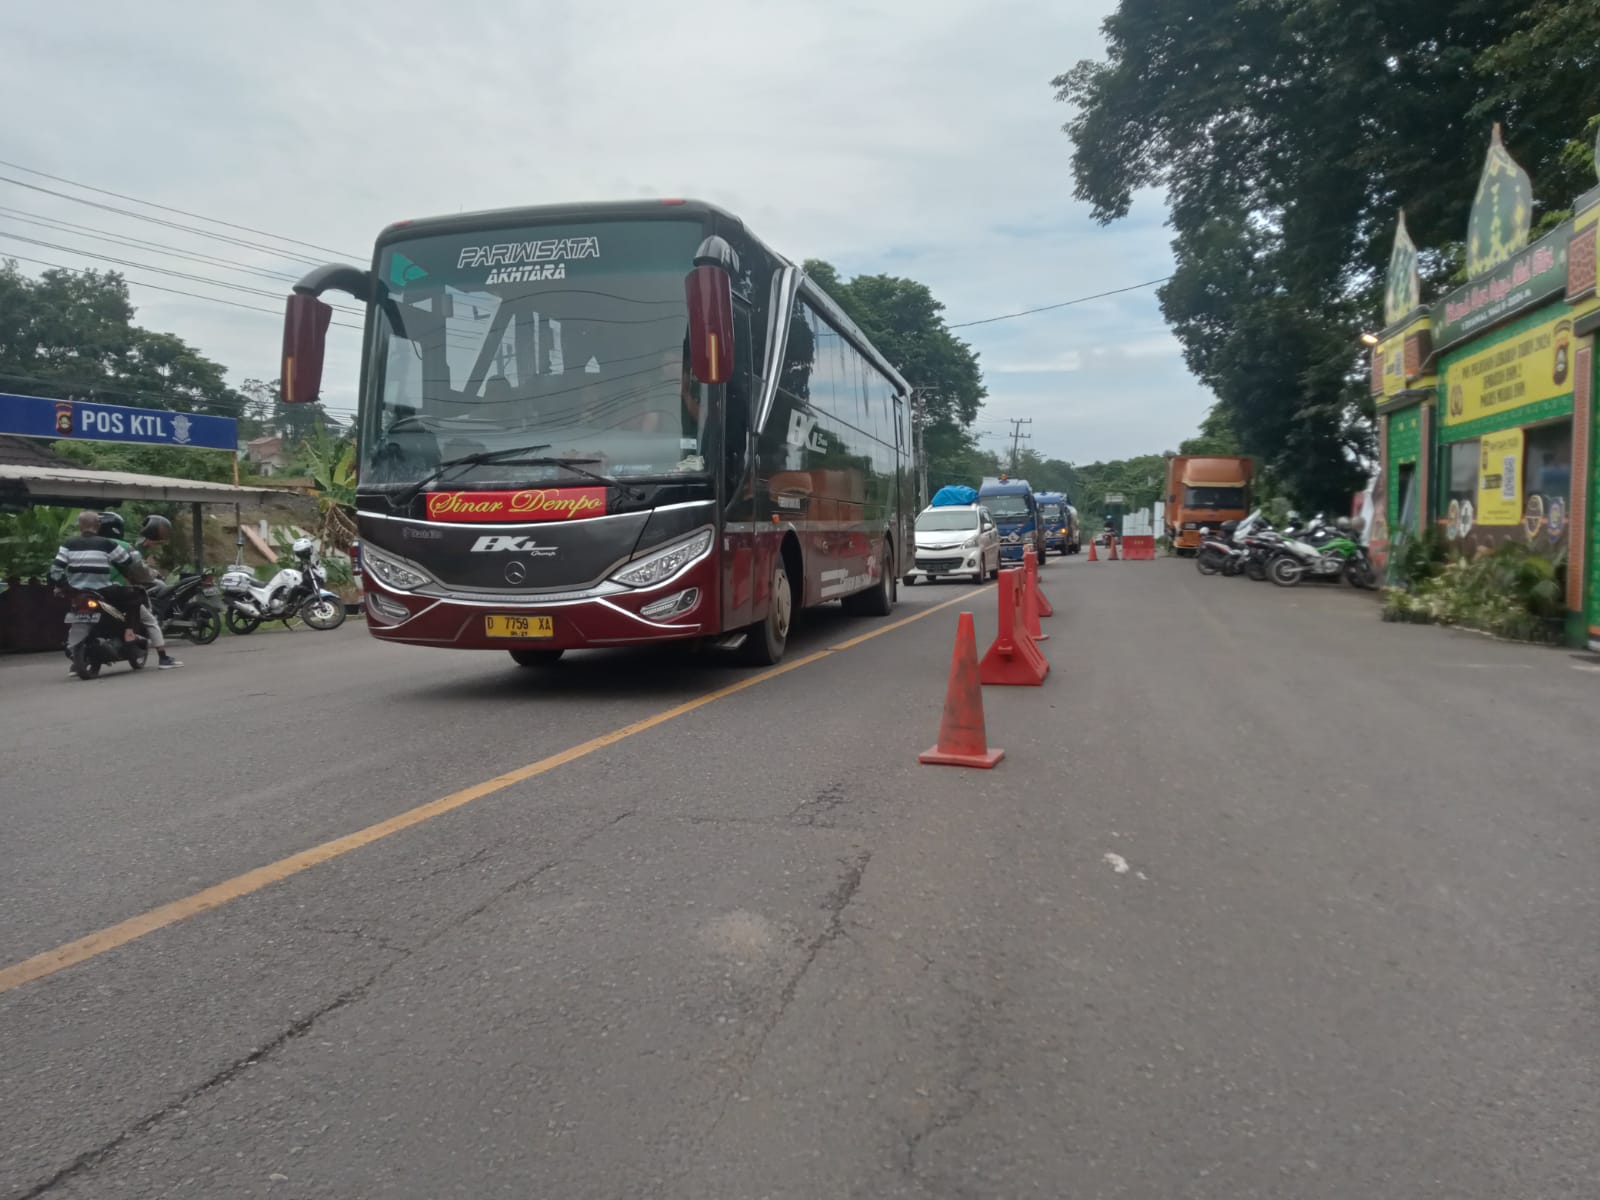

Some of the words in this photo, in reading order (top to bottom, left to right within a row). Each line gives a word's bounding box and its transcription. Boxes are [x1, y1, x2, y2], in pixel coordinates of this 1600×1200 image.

[457, 236, 600, 269] PARIWISATA
[485, 263, 566, 285] AKHTARA
[81, 410, 124, 434] POS
[130, 414, 167, 437] KTL
[429, 491, 503, 519] Sinar
[508, 489, 603, 519] Dempo
[487, 616, 494, 629] D
[504, 617, 529, 630] 7759
[538, 617, 551, 630] XA
